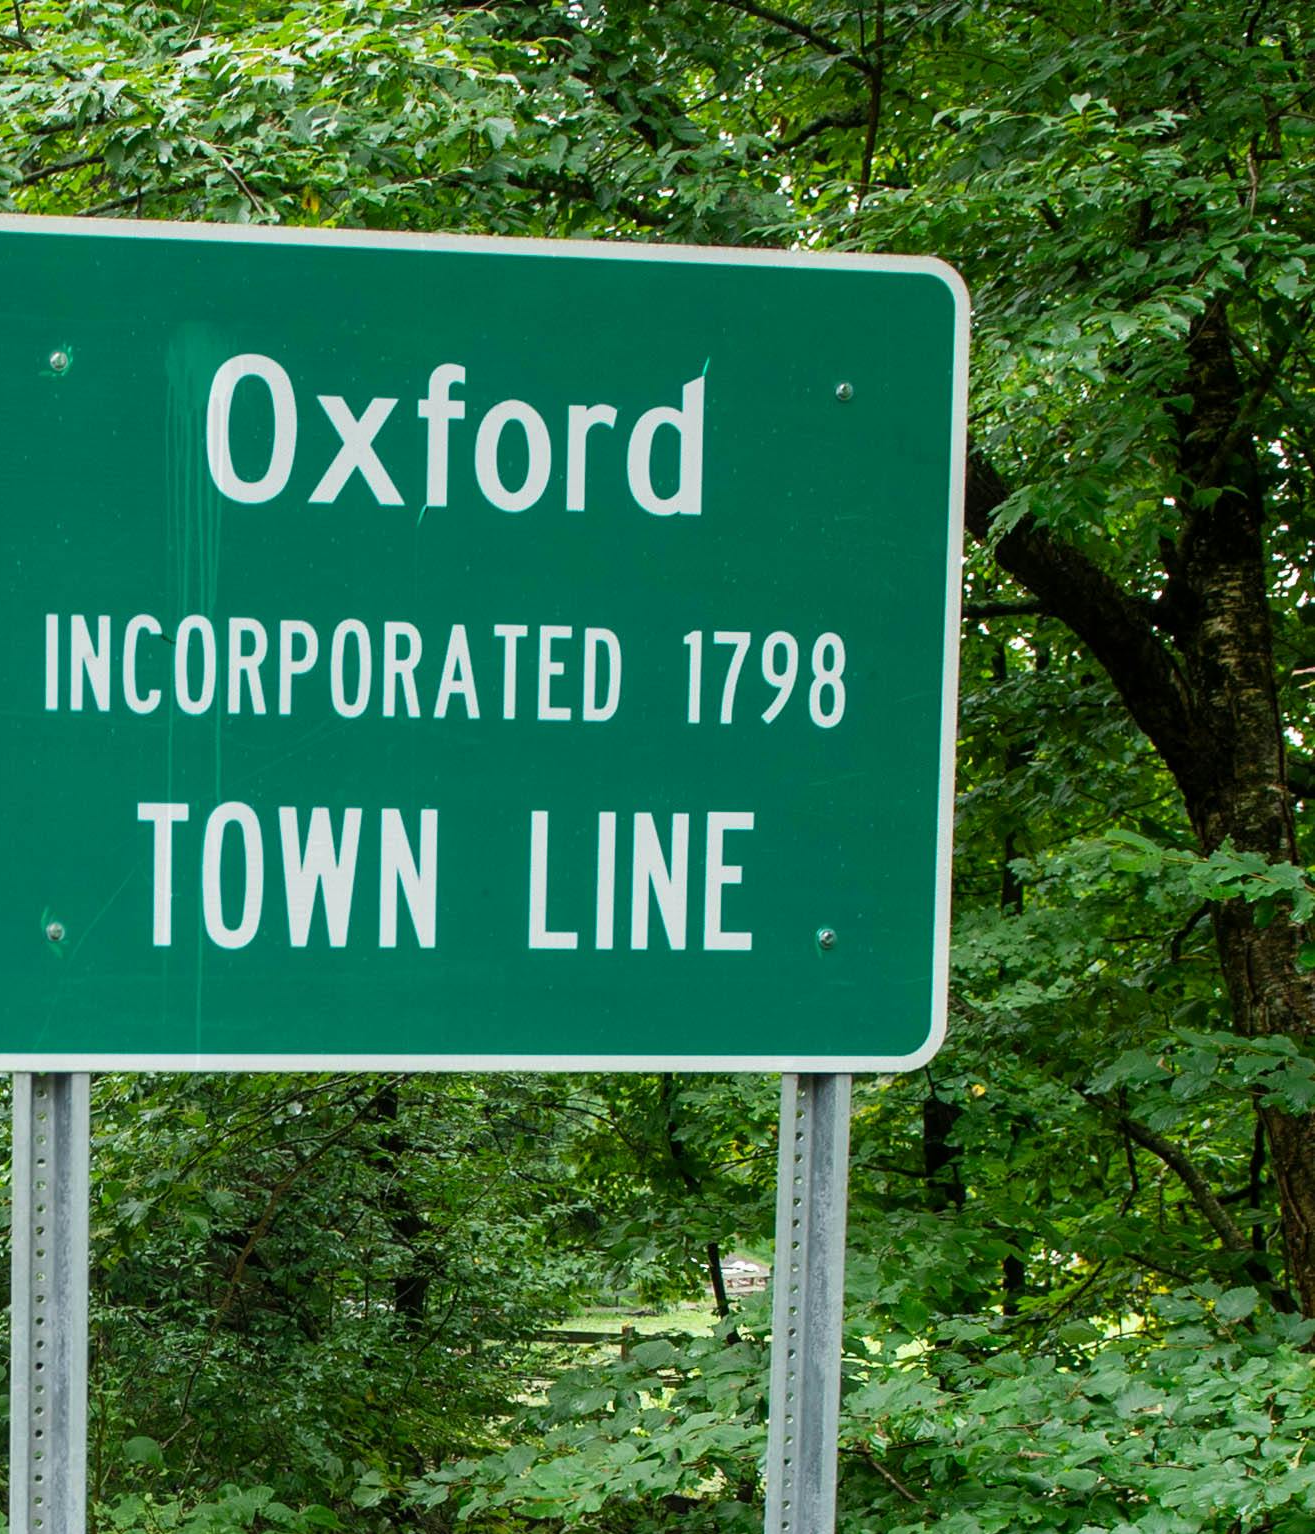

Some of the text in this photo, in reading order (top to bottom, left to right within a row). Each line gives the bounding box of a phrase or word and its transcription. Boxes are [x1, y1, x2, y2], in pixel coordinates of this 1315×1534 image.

[207, 353, 706, 517] Oxford
[45, 613, 847, 729] INCORPORATED 1798
[137, 801, 755, 951] TOWN LINE
